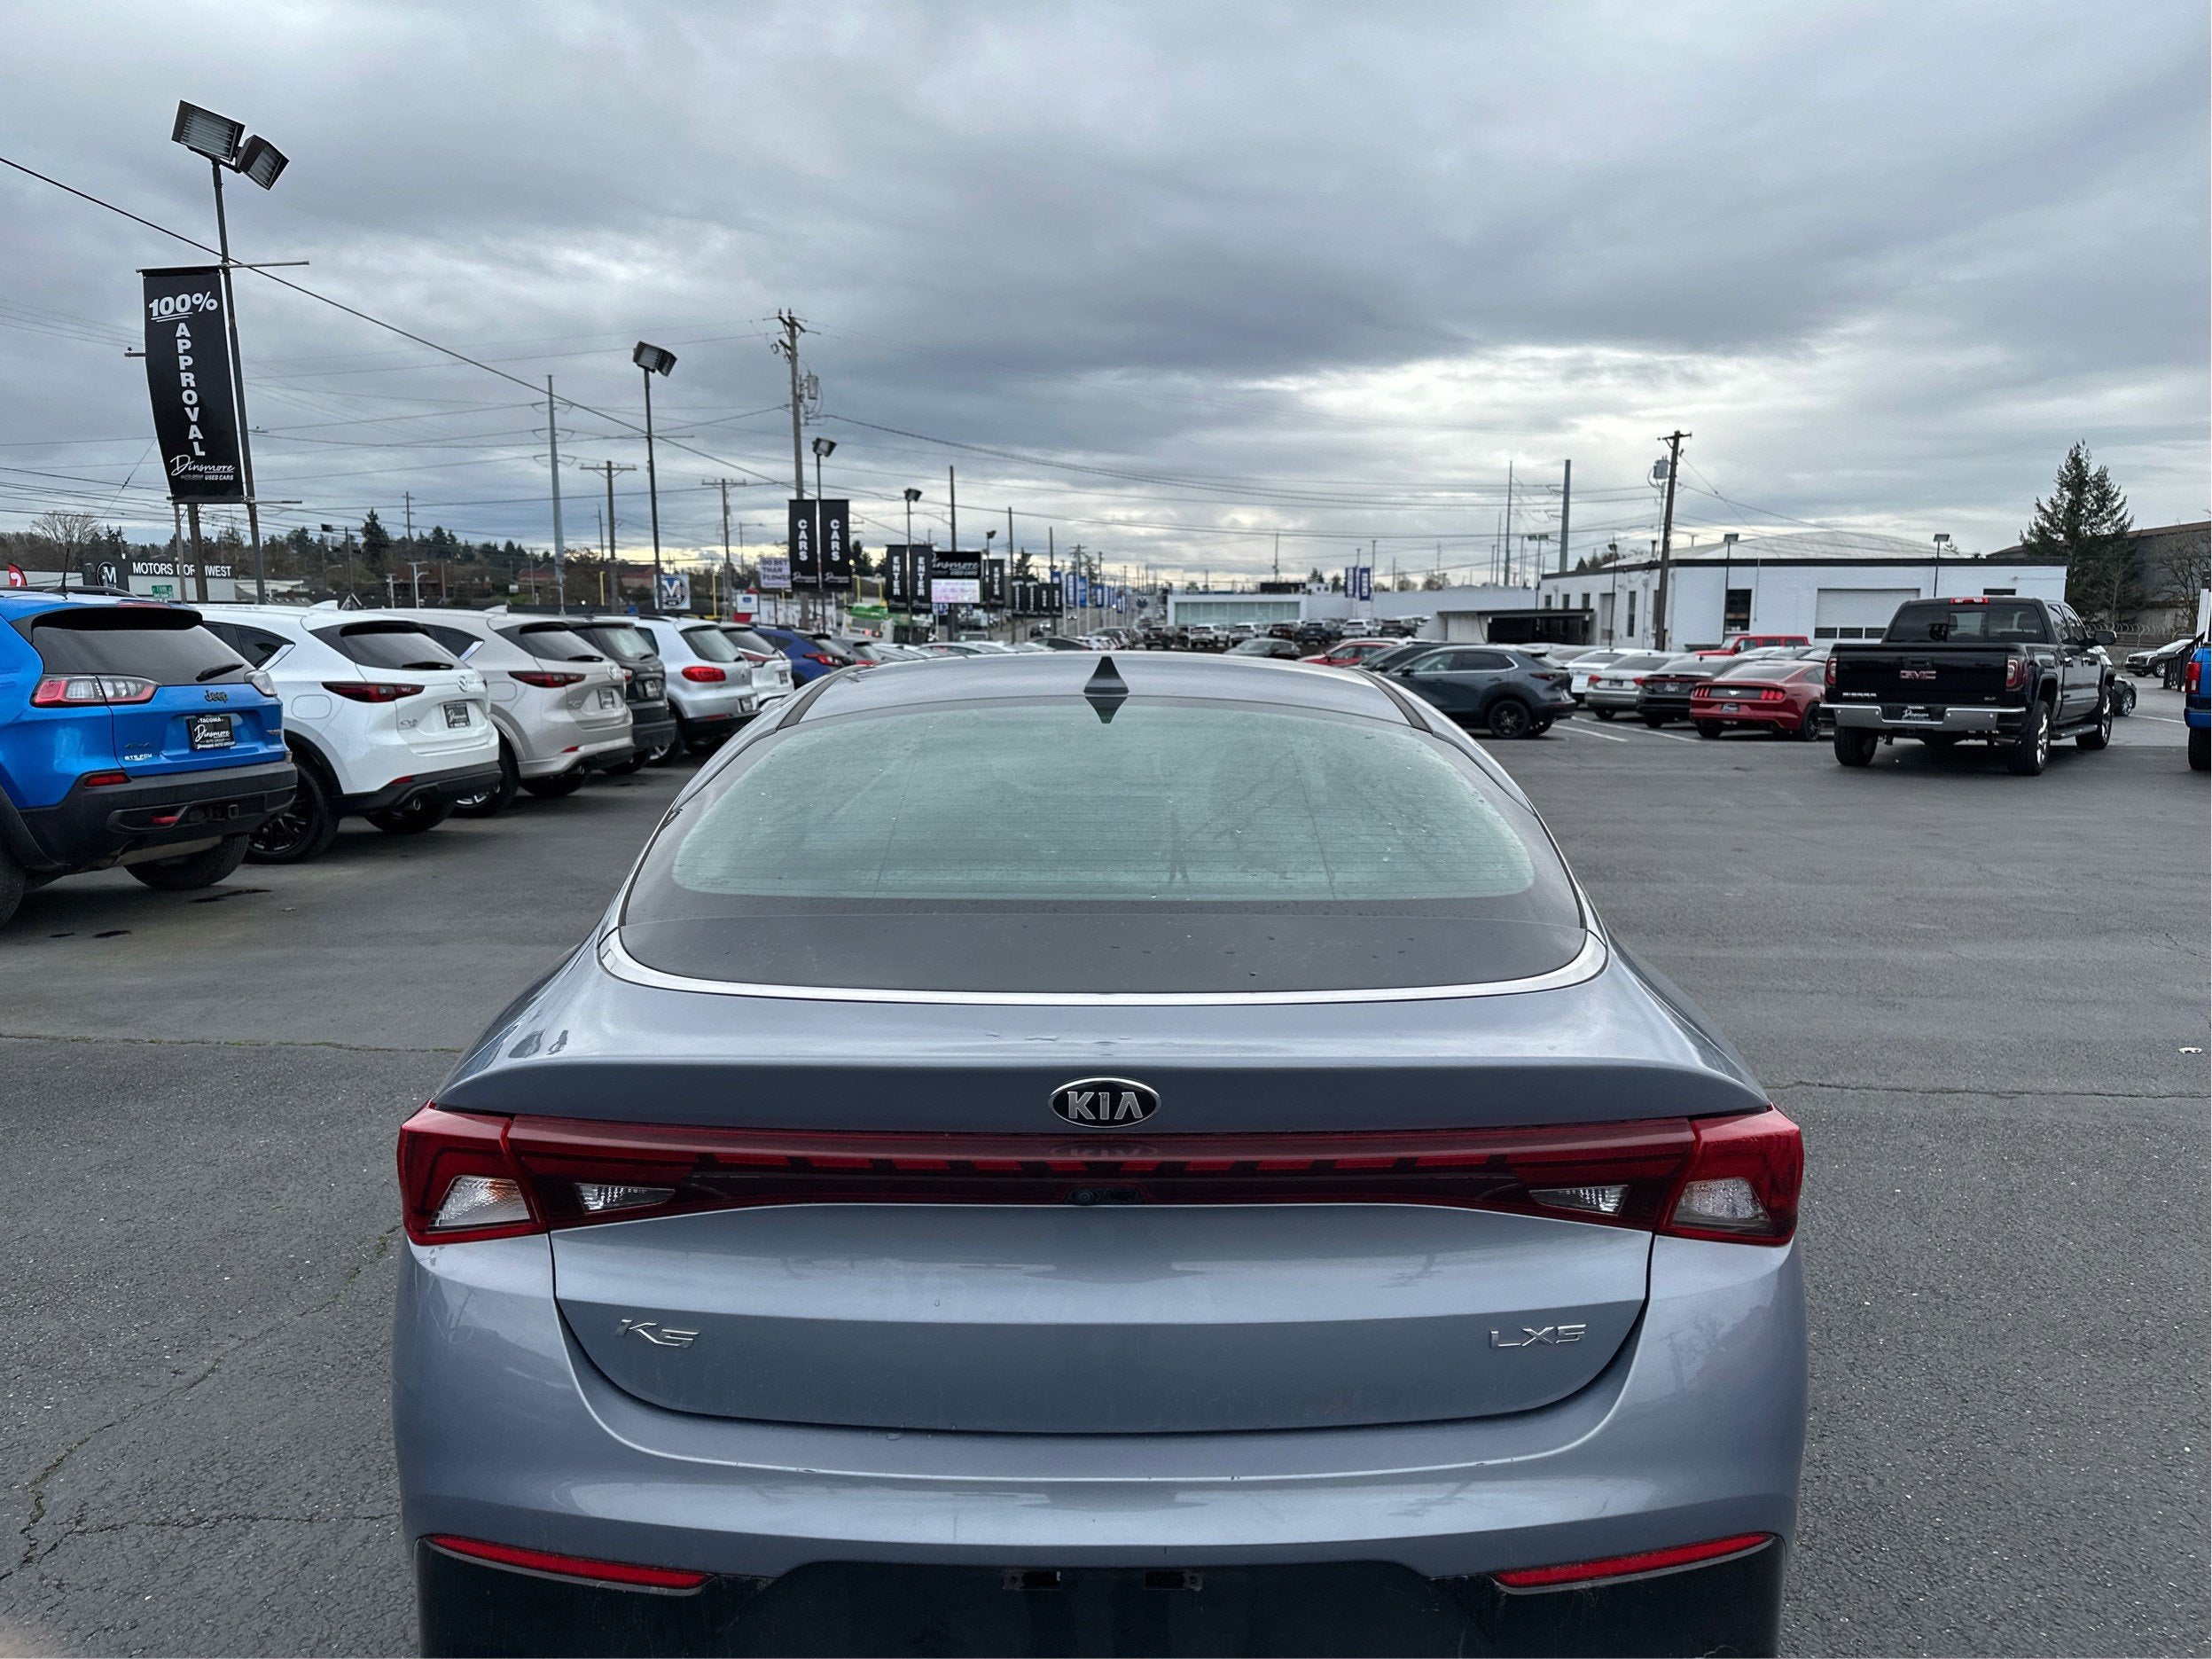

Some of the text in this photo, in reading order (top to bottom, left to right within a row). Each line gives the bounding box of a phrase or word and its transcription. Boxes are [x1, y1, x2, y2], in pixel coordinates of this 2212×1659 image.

[149, 291, 218, 317] 100%
[176, 322, 206, 457] APPROVAL
[170, 454, 235, 476] Dinsmore
[798, 519, 808, 561] CARS
[830, 519, 840, 561] CARS
[132, 561, 174, 575] MOTORS
[1900, 669, 1936, 679] GMC
[205, 690, 229, 703] Jeep
[194, 724, 231, 742] Dinsmore
[1067, 1092, 1143, 1120] KIA
[614, 1319, 700, 1349] K5
[1489, 1324, 1587, 1349] LXS
